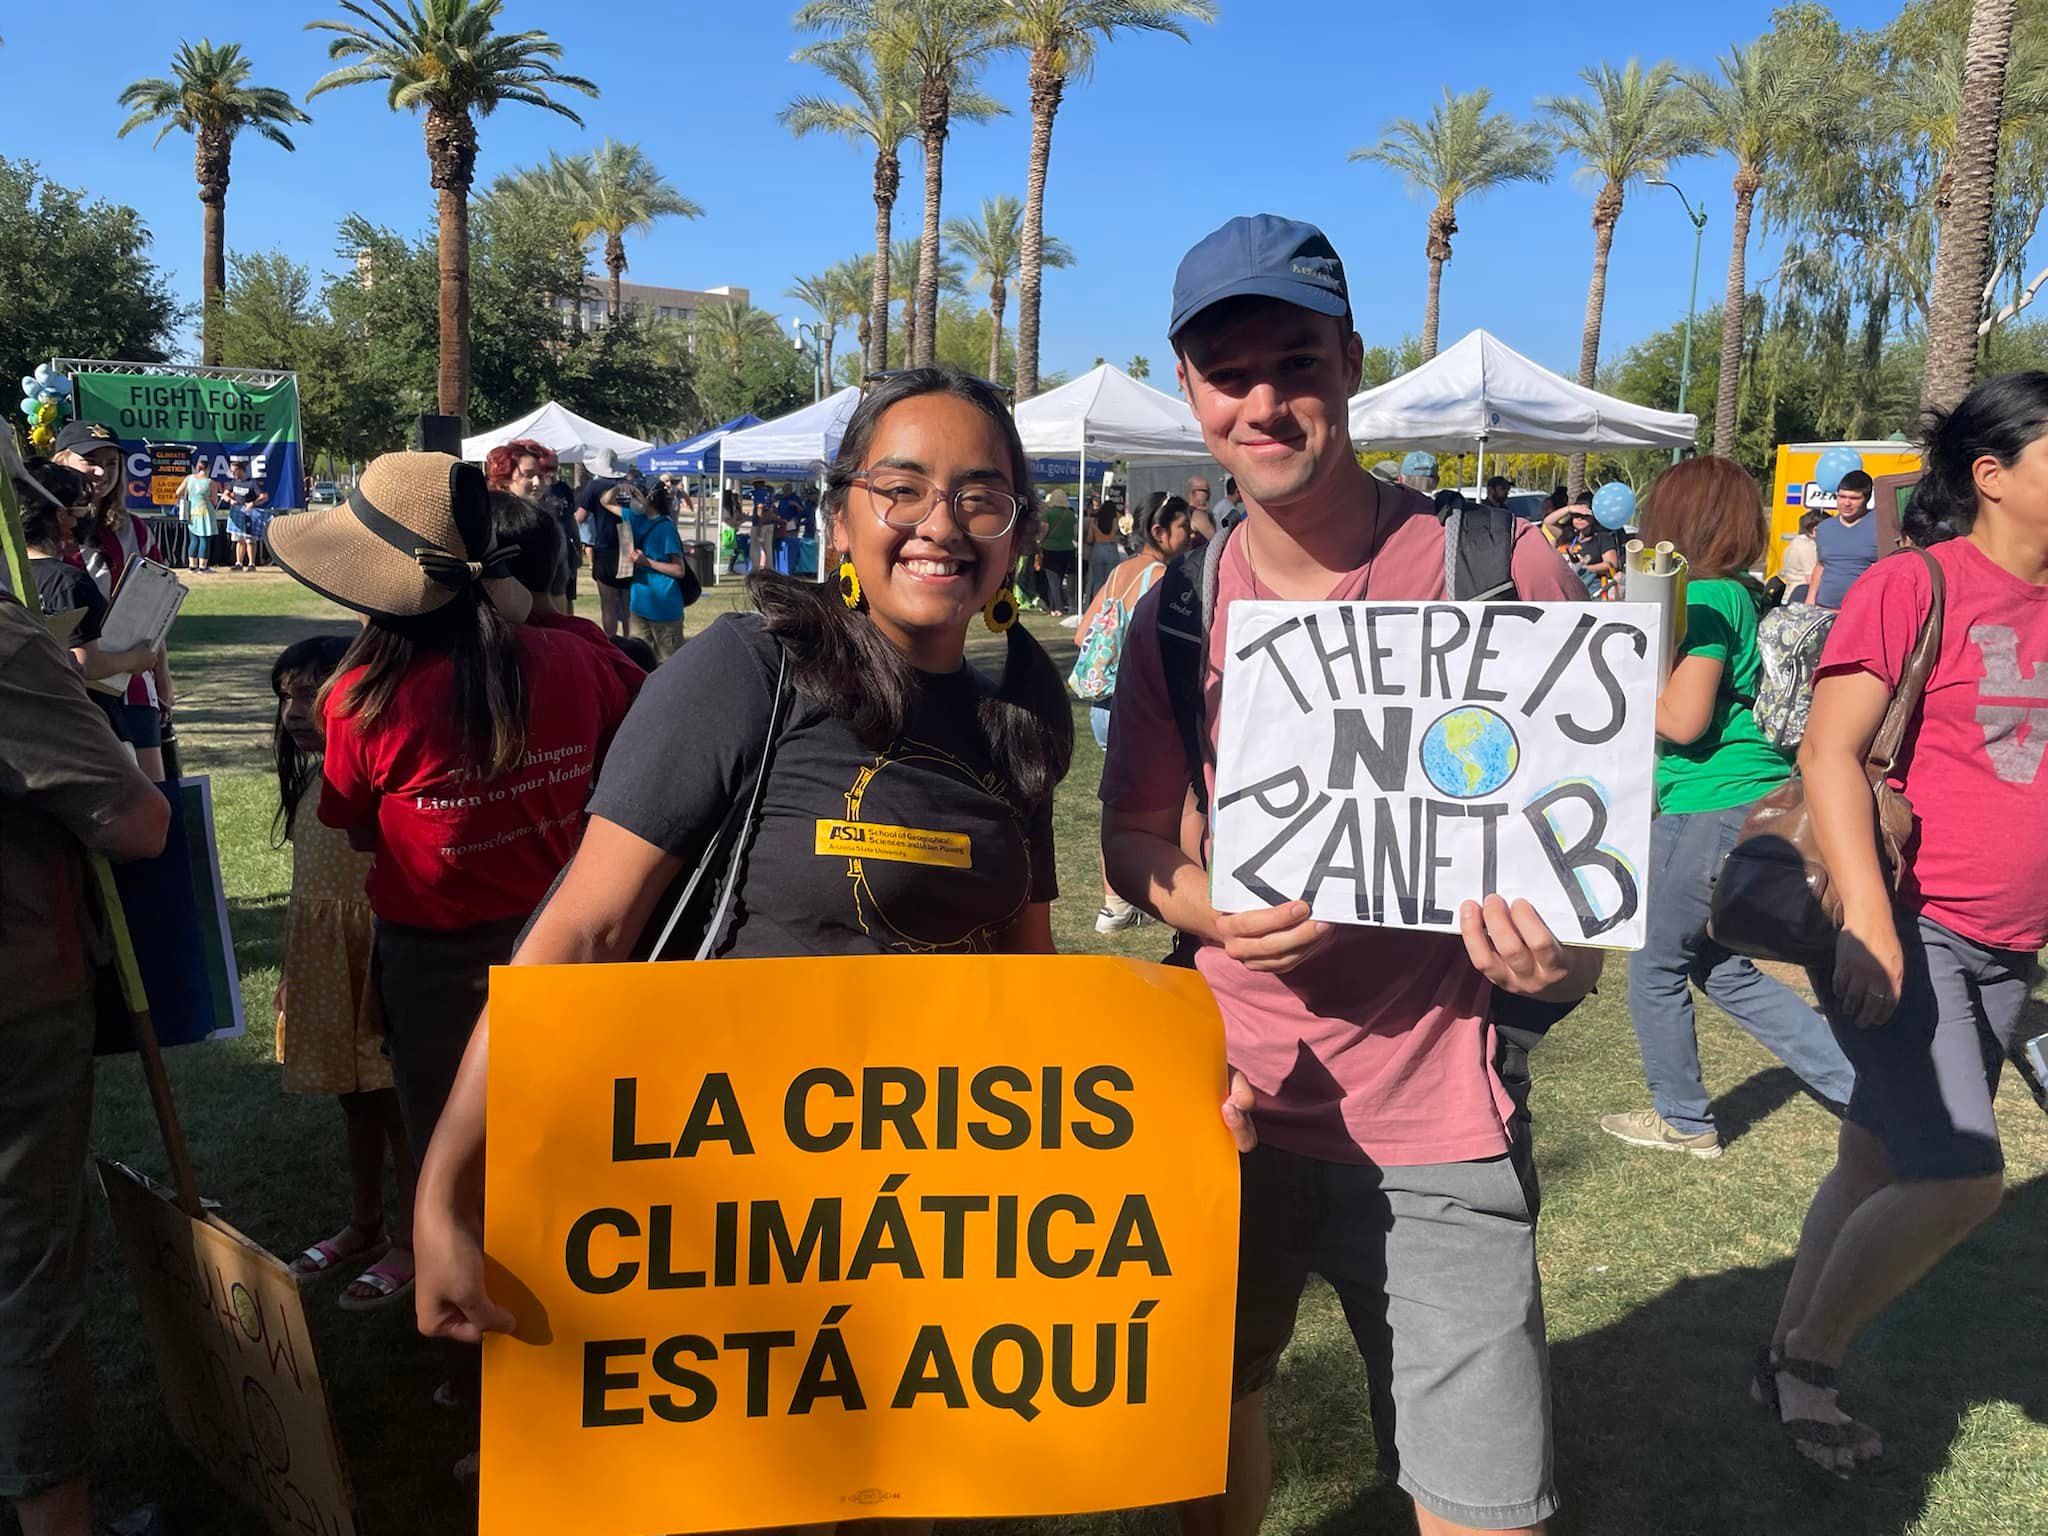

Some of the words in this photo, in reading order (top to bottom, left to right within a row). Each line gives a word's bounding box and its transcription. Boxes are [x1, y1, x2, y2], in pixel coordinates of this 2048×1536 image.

[130, 386, 201, 408] FIGHT
[208, 390, 254, 410] FOR
[119, 408, 170, 429] OUR
[177, 410, 266, 431] FUTURE
[1235, 605, 1545, 715] THERE
[1520, 613, 1648, 745] IS
[415, 795, 482, 811] Listen
[488, 789, 505, 801] to
[510, 777, 545, 800] your
[829, 825, 866, 842] ASU
[868, 828, 897, 839] School
[897, 832, 907, 840] of
[869, 837, 906, 847] Sciences
[875, 848, 907, 857] University
[1218, 765, 1509, 925] PLANET
[1521, 782, 1638, 939] B
[611, 1072, 756, 1163] LA
[783, 1064, 1136, 1154] CRISIS
[564, 1172, 1173, 1296] CLIMÁTICA
[581, 1304, 868, 1429] ESTÁ
[890, 1299, 1161, 1424] AQUÍ
